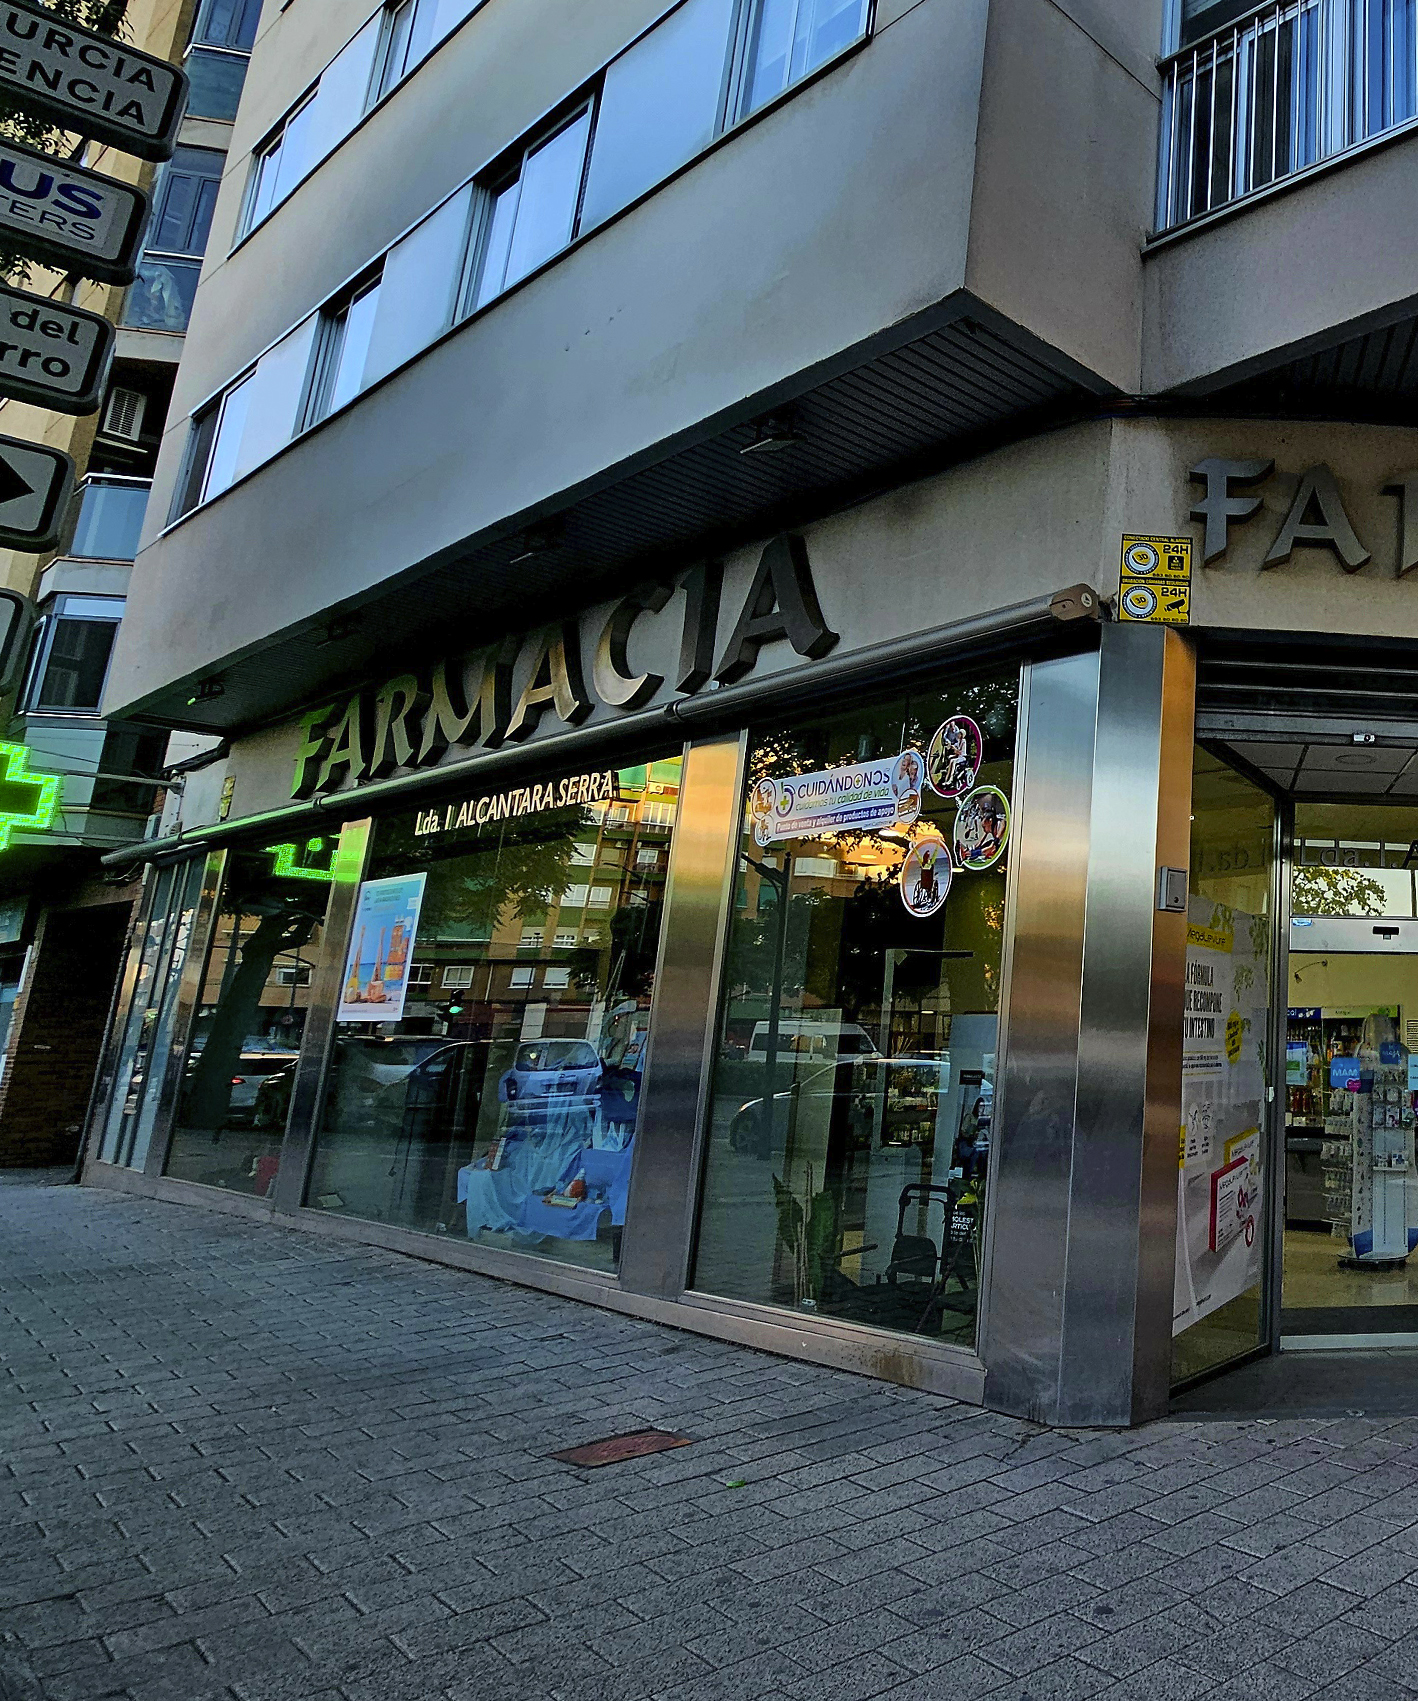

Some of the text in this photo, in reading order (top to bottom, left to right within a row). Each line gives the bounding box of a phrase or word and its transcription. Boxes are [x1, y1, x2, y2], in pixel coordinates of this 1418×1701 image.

[6, 11, 156, 93] URCIA
[0, 49, 146, 127] ENCIA
[0, 194, 96, 240] ERS
[9, 308, 80, 346] del
[1163, 544, 1189, 555] 24H
[1161, 587, 1187, 597] 24H
[291, 533, 839, 799] FARMACIA
[414, 808, 441, 836] Lda.
[455, 782, 555, 829] ALCANTARA
[556, 769, 615, 808] SERRA
[837, 790, 863, 804] calidad
[863, 787, 873, 800] de
[873, 785, 890, 798] vida
[835, 812, 843, 822] de
[843, 807, 870, 823] productos
[870, 806, 878, 817] de
[878, 803, 896, 819] apoyo
[1300, 839, 1370, 868] Lda.
[1332, 1068, 1359, 1077] MAM
